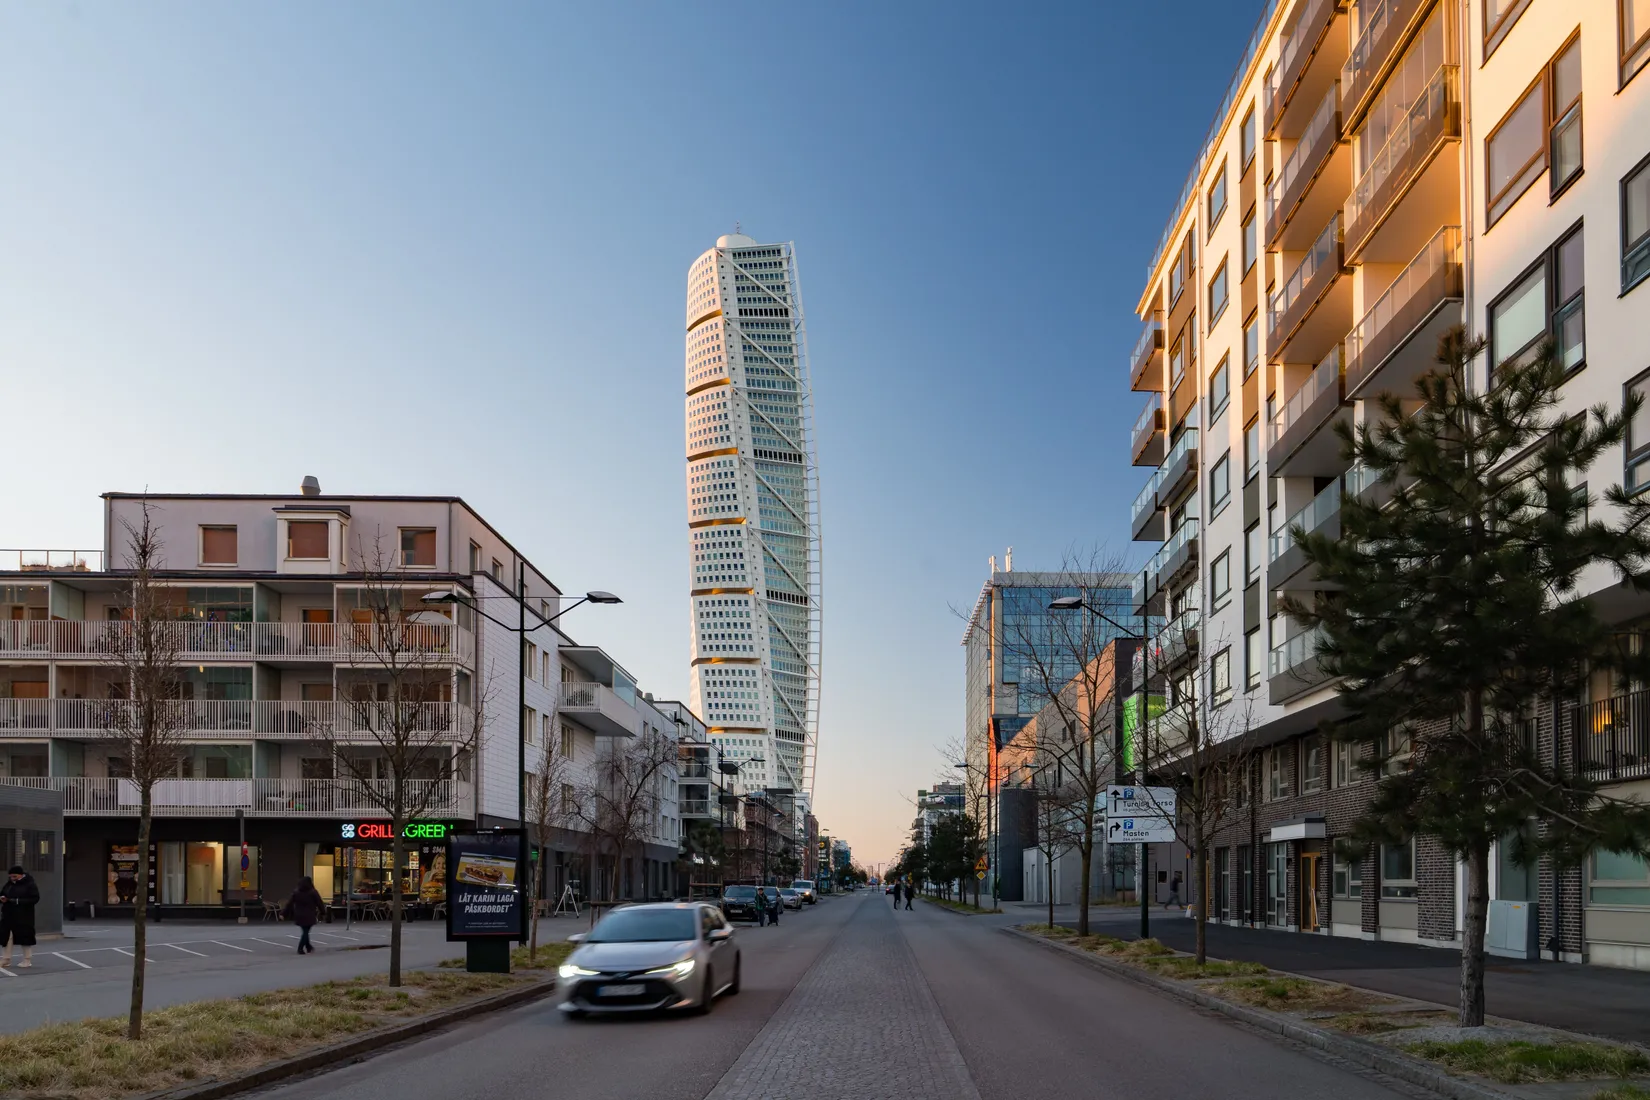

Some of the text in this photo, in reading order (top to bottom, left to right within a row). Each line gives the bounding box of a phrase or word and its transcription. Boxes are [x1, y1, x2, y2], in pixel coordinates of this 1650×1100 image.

[358, 824, 394, 838] GRILL
[458, 892, 515, 903] LÅT KARIN LAGA
